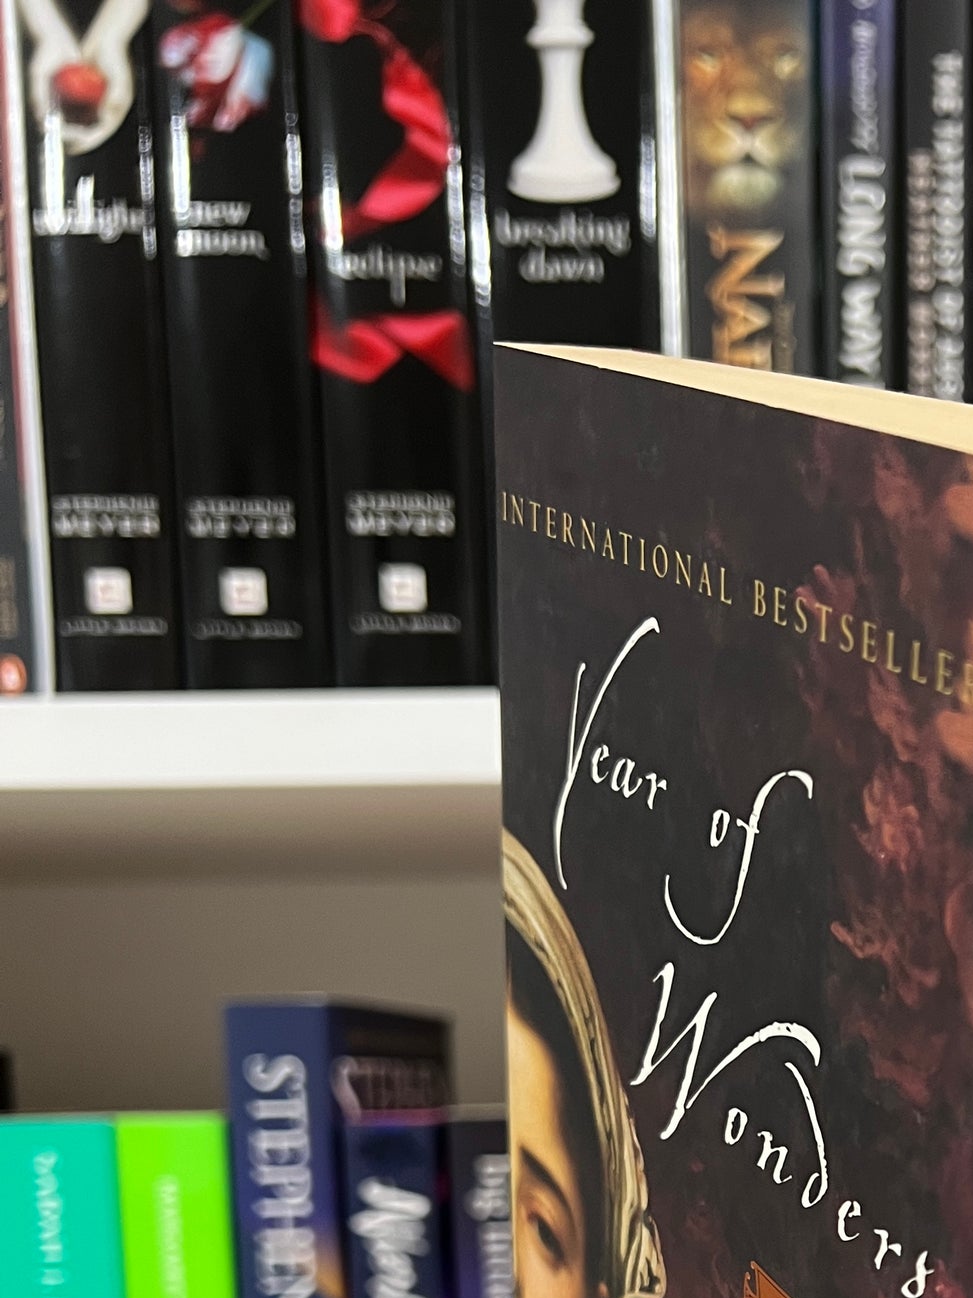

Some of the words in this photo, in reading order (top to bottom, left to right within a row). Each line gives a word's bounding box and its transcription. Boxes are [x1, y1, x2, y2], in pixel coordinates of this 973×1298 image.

[837, 156, 887, 278] LONG
[502, 491, 733, 605] INTERNATIONAL
[554, 616, 668, 890] Year
[664, 769, 815, 945] of
[630, 962, 935, 1298] Wonders
